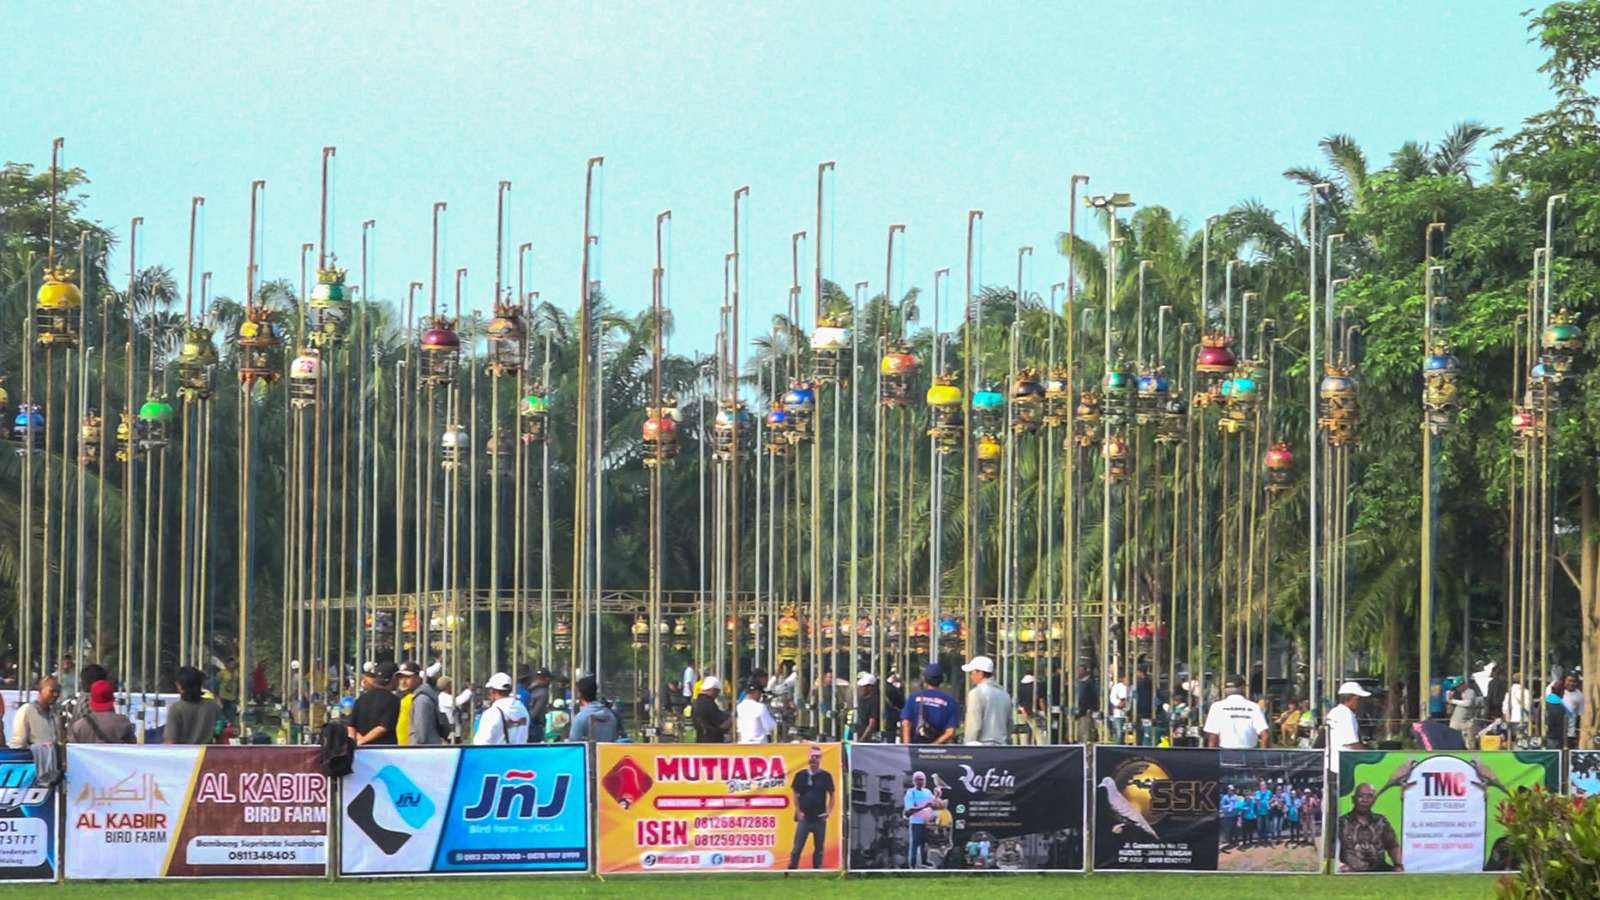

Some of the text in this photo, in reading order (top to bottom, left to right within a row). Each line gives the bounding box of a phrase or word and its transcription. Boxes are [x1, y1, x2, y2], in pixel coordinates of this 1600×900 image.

[197, 773, 236, 803] AL
[958, 764, 1016, 793] Rafzia
[1421, 772, 1467, 797] TMC
[1151, 781, 1217, 811] SSK
[76, 814, 101, 828] AL
[244, 806, 326, 822] BIRD FARM
[105, 832, 167, 843] BIRD FARM
[637, 821, 688, 845] ISEN
